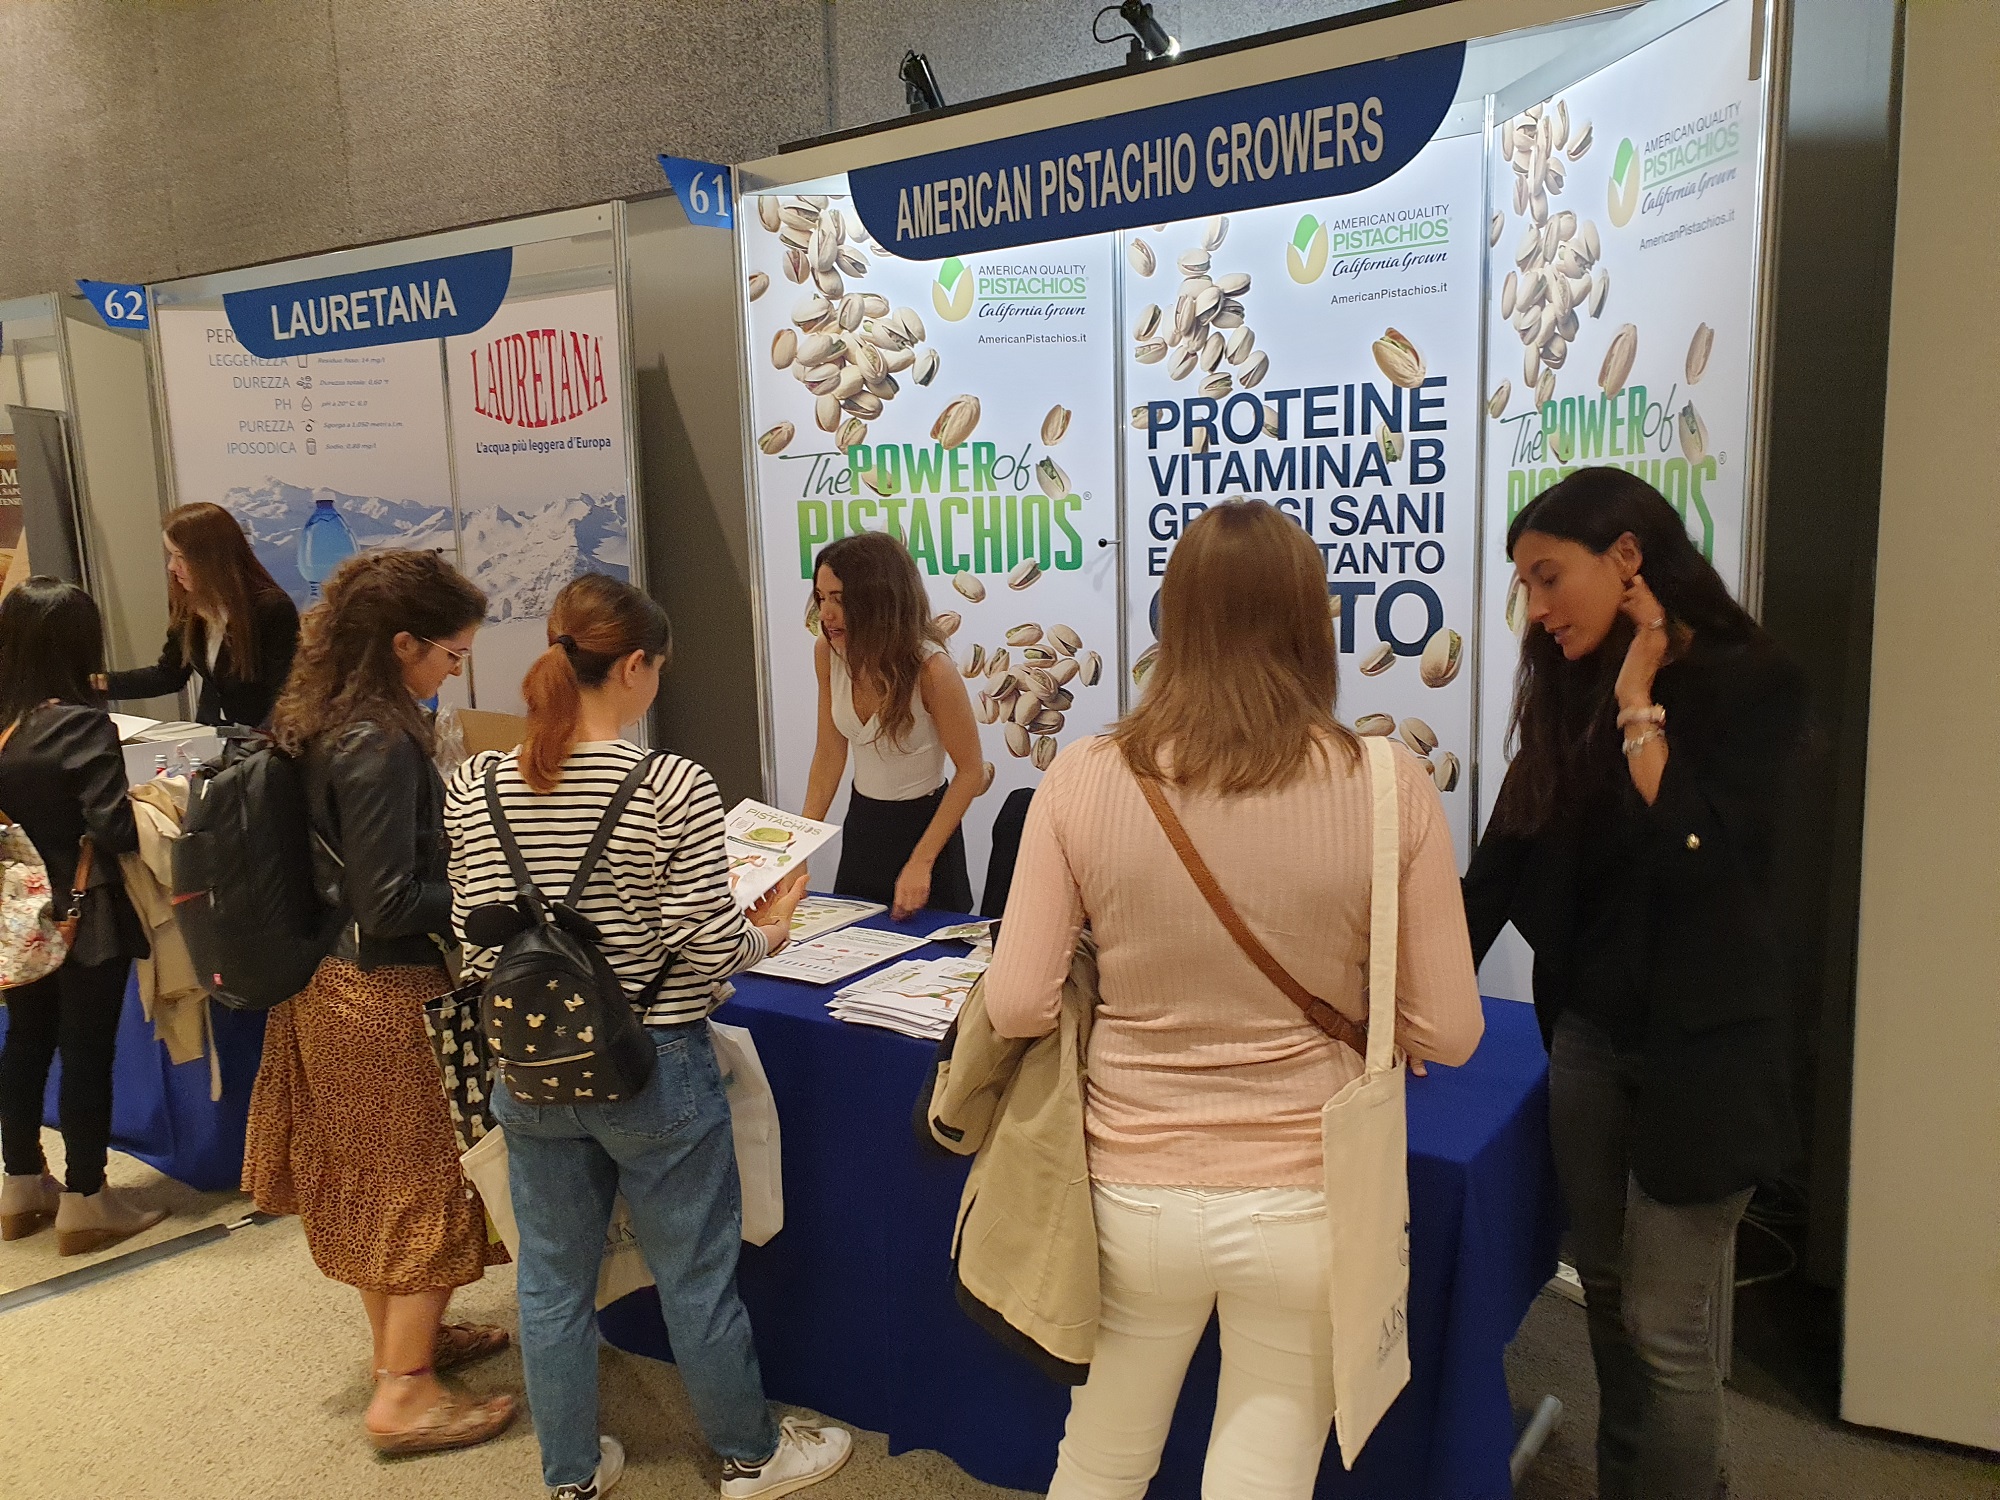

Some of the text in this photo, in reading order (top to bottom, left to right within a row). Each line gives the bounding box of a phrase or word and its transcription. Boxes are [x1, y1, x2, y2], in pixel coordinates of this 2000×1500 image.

[1644, 100, 1742, 155] AMERICAN QUALITY
[1643, 121, 1739, 182] PISTACHIOS
[896, 96, 1384, 242] AMERICAN PISTACHIO GROWERS
[689, 171, 729, 217] 61
[1641, 168, 1737, 216] California Grown
[1333, 204, 1449, 231] AMERICAN QUALITY
[1639, 209, 1735, 250] AmericanPistachios.it
[1333, 218, 1449, 252] PISTACHIOS
[978, 264, 1086, 276] AMERICAN QUALITY
[1332, 251, 1448, 280] California Grown
[978, 276, 1086, 295] PISTACHIOS
[1330, 282, 1448, 305] AmericanPistachios.it
[104, 289, 145, 321] 62
[271, 278, 457, 341] LAURETANA
[978, 302, 1086, 323] California Grown
[206, 328, 237, 343] PER
[978, 333, 1087, 344] AmericanPistachios.it
[208, 354, 288, 367] LEGGEREZZA
[232, 376, 291, 389] DUREZZA
[470, 328, 608, 429] LAURETANA
[275, 398, 292, 410] PH
[1147, 376, 1448, 450] PROTEINE
[239, 419, 295, 432] PUREZZA
[1500, 383, 1676, 467] The POWER of
[226, 441, 297, 454] IPOSODICA
[476, 436, 611, 456] L'acqua più leggera d'Europa
[778, 441, 1032, 498] The POWER of
[1148, 438, 1446, 497] VITAMINA B
[1328, 491, 1444, 536] SANI
